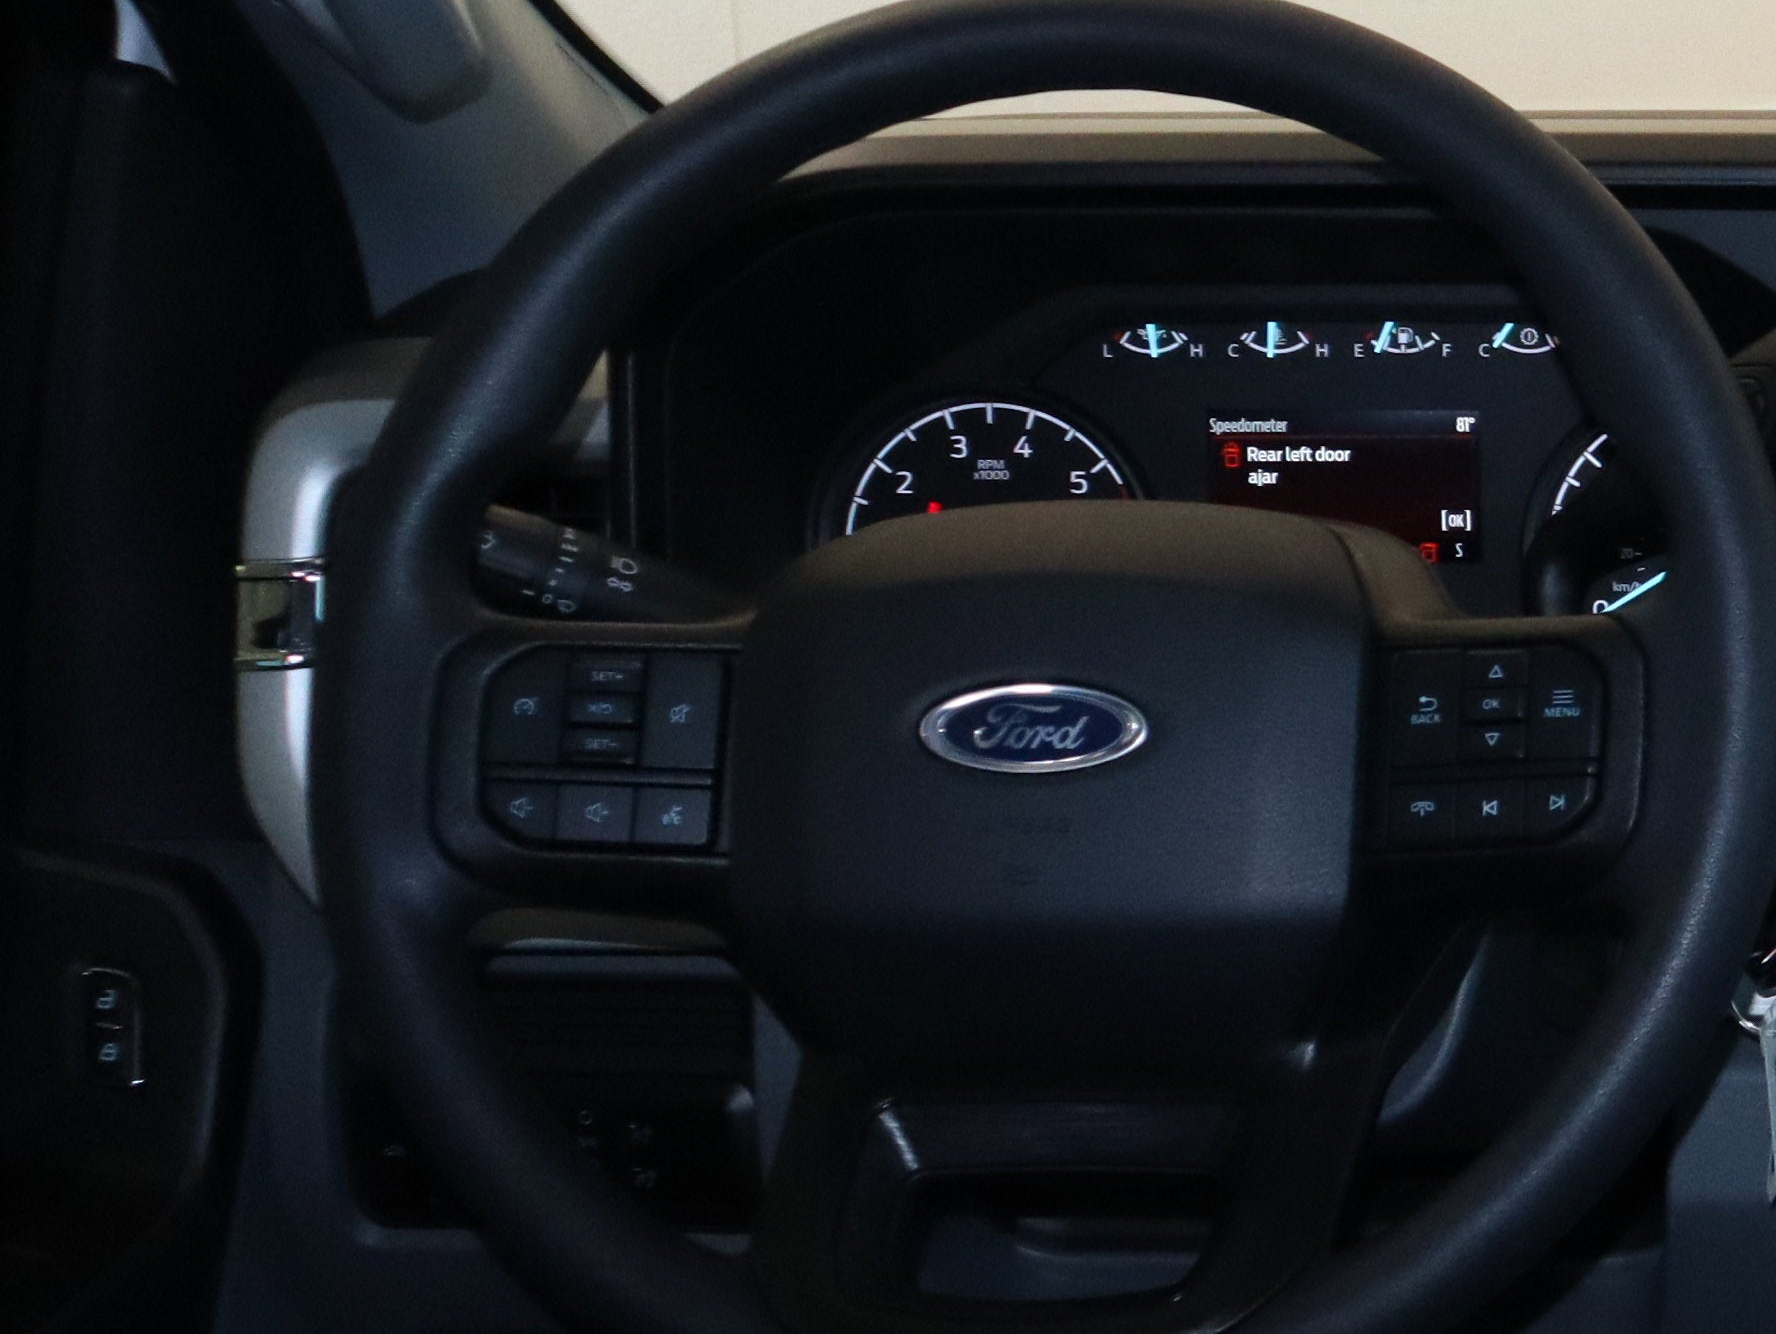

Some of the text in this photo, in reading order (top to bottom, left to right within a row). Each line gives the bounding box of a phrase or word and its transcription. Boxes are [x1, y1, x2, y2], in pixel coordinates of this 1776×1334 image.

[1103, 344, 1113, 358] L
[1190, 344, 1203, 358] H
[1228, 344, 1240, 358] C
[1316, 344, 1329, 358] H
[1354, 344, 1365, 358] E
[1442, 344, 1452, 358] F
[1479, 344, 1490, 358] C
[1209, 416, 1476, 434] Speedometer 81°
[949, 435, 968, 458] 3
[1013, 435, 1034, 458] 4
[1247, 446, 1351, 462] Rear left door
[977, 459, 1006, 470] RPM
[895, 470, 915, 494] 2
[1069, 470, 1089, 494] 5
[1248, 470, 1278, 486] ajar
[1481, 698, 1502, 710] OK
[1410, 712, 1441, 725] BACK
[1544, 707, 1580, 718] MENU
[973, 702, 1086, 751] Ford
